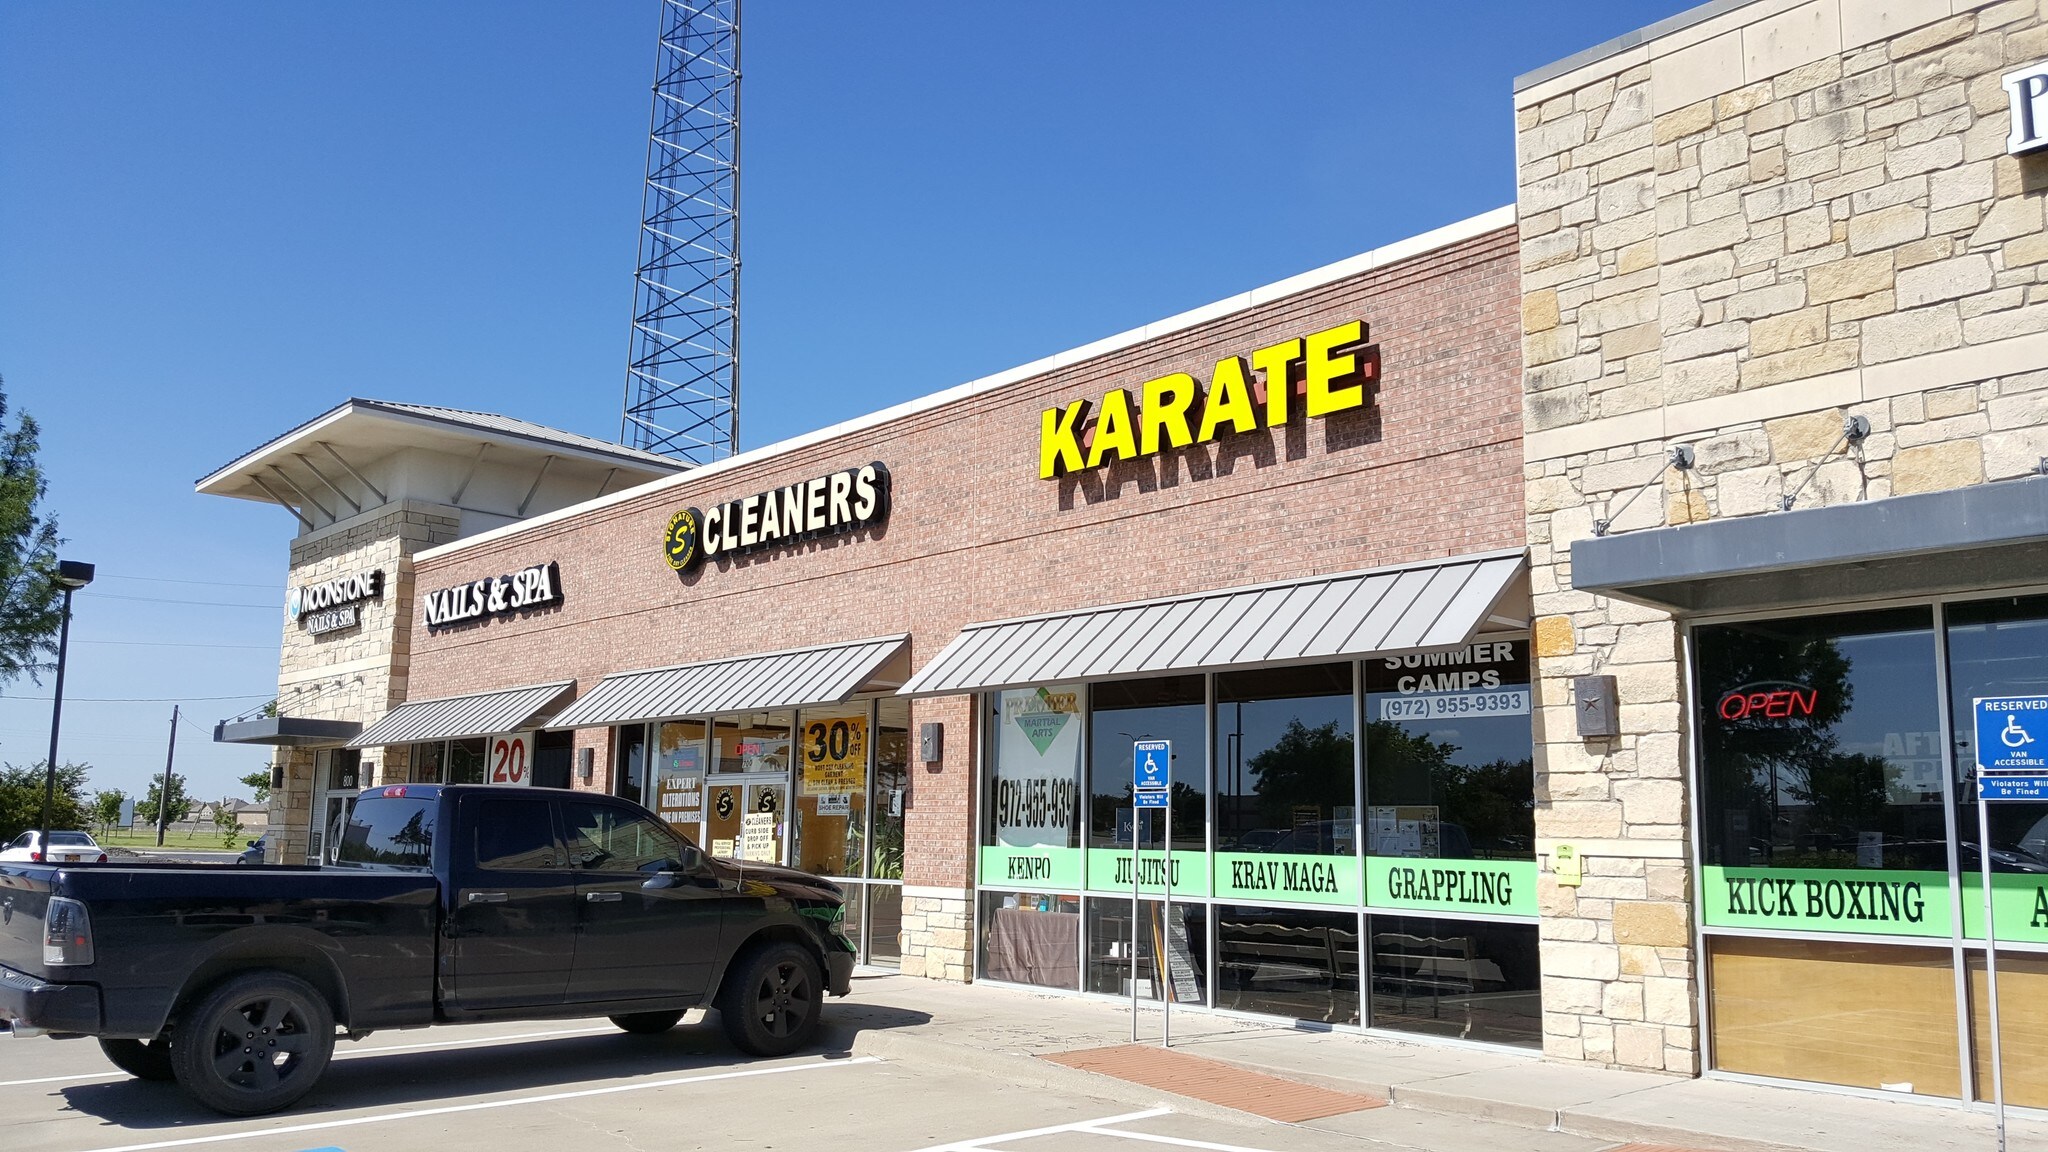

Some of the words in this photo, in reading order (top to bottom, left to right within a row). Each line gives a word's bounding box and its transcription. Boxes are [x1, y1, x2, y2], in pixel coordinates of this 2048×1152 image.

[1040, 320, 1362, 479] KARATE
[703, 465, 876, 554] CLEANERS
[665, 512, 695, 542] SIGNATURE
[672, 525, 688, 554] S
[301, 570, 375, 613] MOONSTONE
[422, 580, 485, 626] NAILS
[487, 578, 509, 612] &
[511, 564, 553, 608] SPA
[308, 611, 331, 634] NAILS
[331, 612, 338, 629] &
[340, 606, 355, 626] SPA
[1385, 642, 1515, 670] SUMMER
[1398, 670, 1500, 695] CAMPS
[1385, 699, 1431, 719] (972)
[1437, 693, 1522, 714] 955-9393
[1720, 690, 1817, 719] OPEN
[1985, 700, 2048, 711] RESERVED
[1024, 717, 1061, 728] MARTIAL
[1032, 728, 1053, 738] ARTS
[736, 744, 760, 755] OPEN
[808, 720, 849, 762] 30
[850, 722, 861, 740] %
[850, 743, 861, 756] OFF
[1139, 743, 1165, 751] RESERVED
[493, 738, 525, 783] 20
[343, 775, 353, 787] 800
[666, 777, 696, 790] EXPERT
[720, 797, 729, 812] S
[762, 796, 771, 811] S
[1008, 856, 1050, 880] KENPO
[1231, 860, 1279, 891] KRAV
[1283, 861, 1338, 893] MAGA
[1388, 866, 1513, 906] GRAPPLING
[1726, 877, 1798, 917] KICK
[1804, 879, 1925, 923] BOXING
